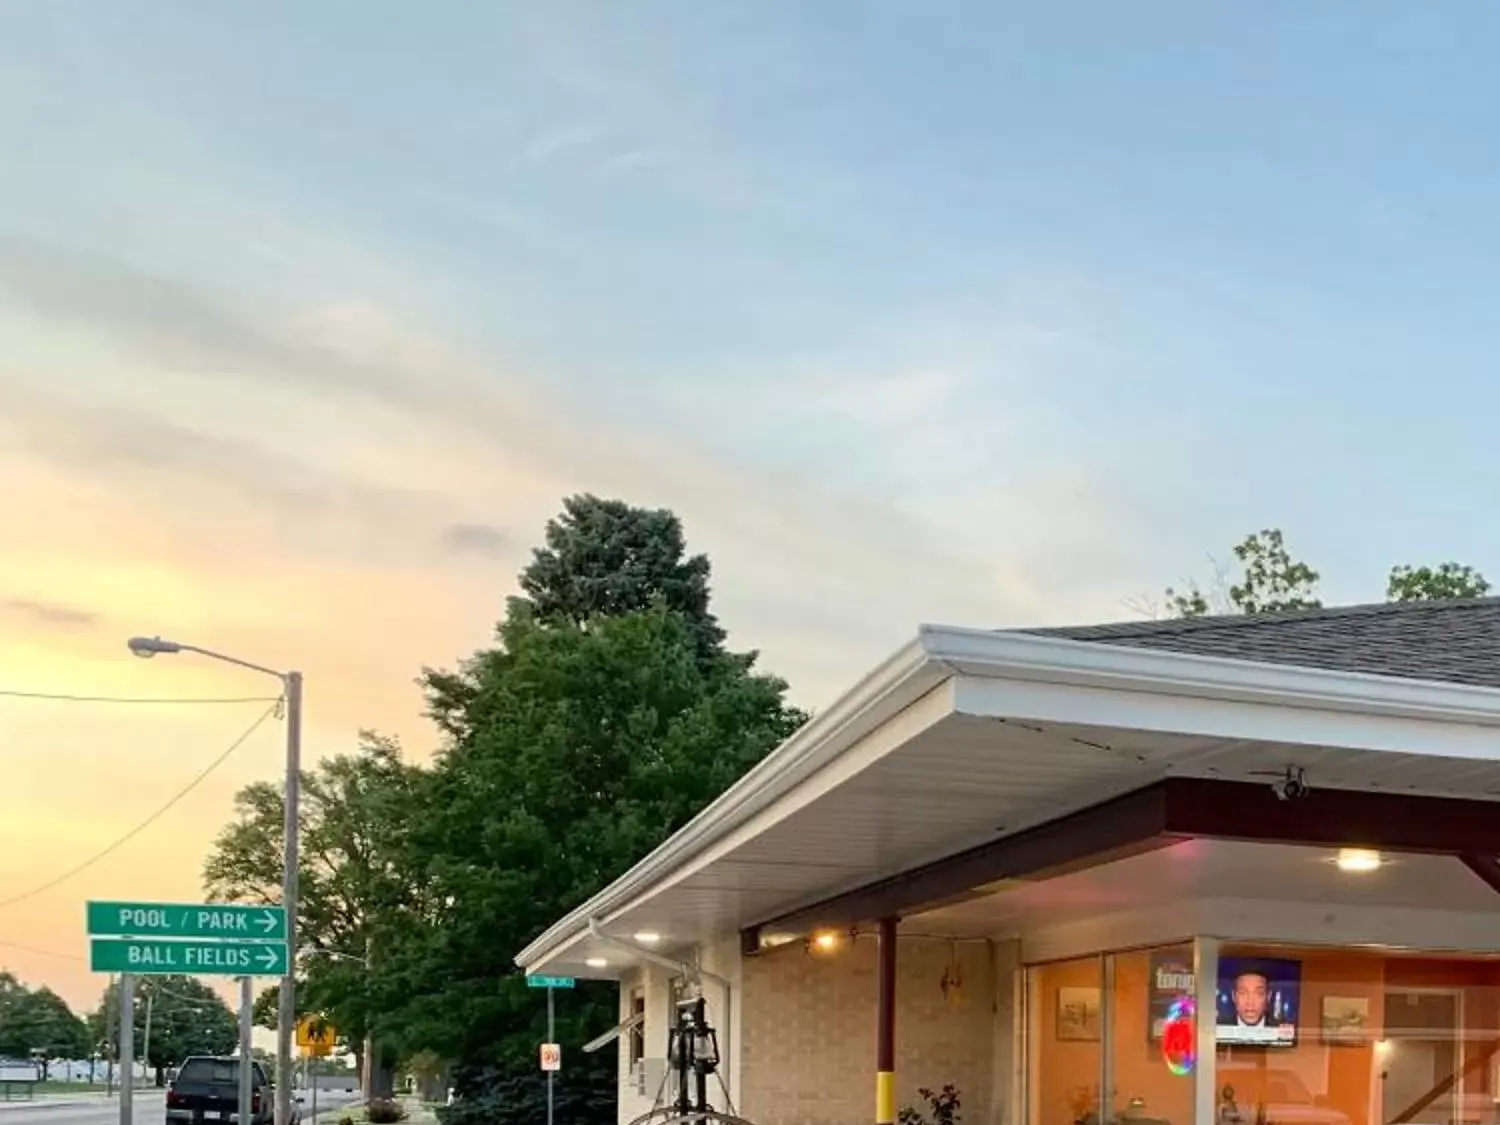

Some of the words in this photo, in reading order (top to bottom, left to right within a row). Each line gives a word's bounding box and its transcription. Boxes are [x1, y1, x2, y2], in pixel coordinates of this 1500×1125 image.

[119, 908, 171, 928] POOL
[181, 911, 189, 929] /
[197, 911, 248, 931] PARK
[128, 945, 176, 965] BALL
[185, 947, 250, 966] FIELDS
